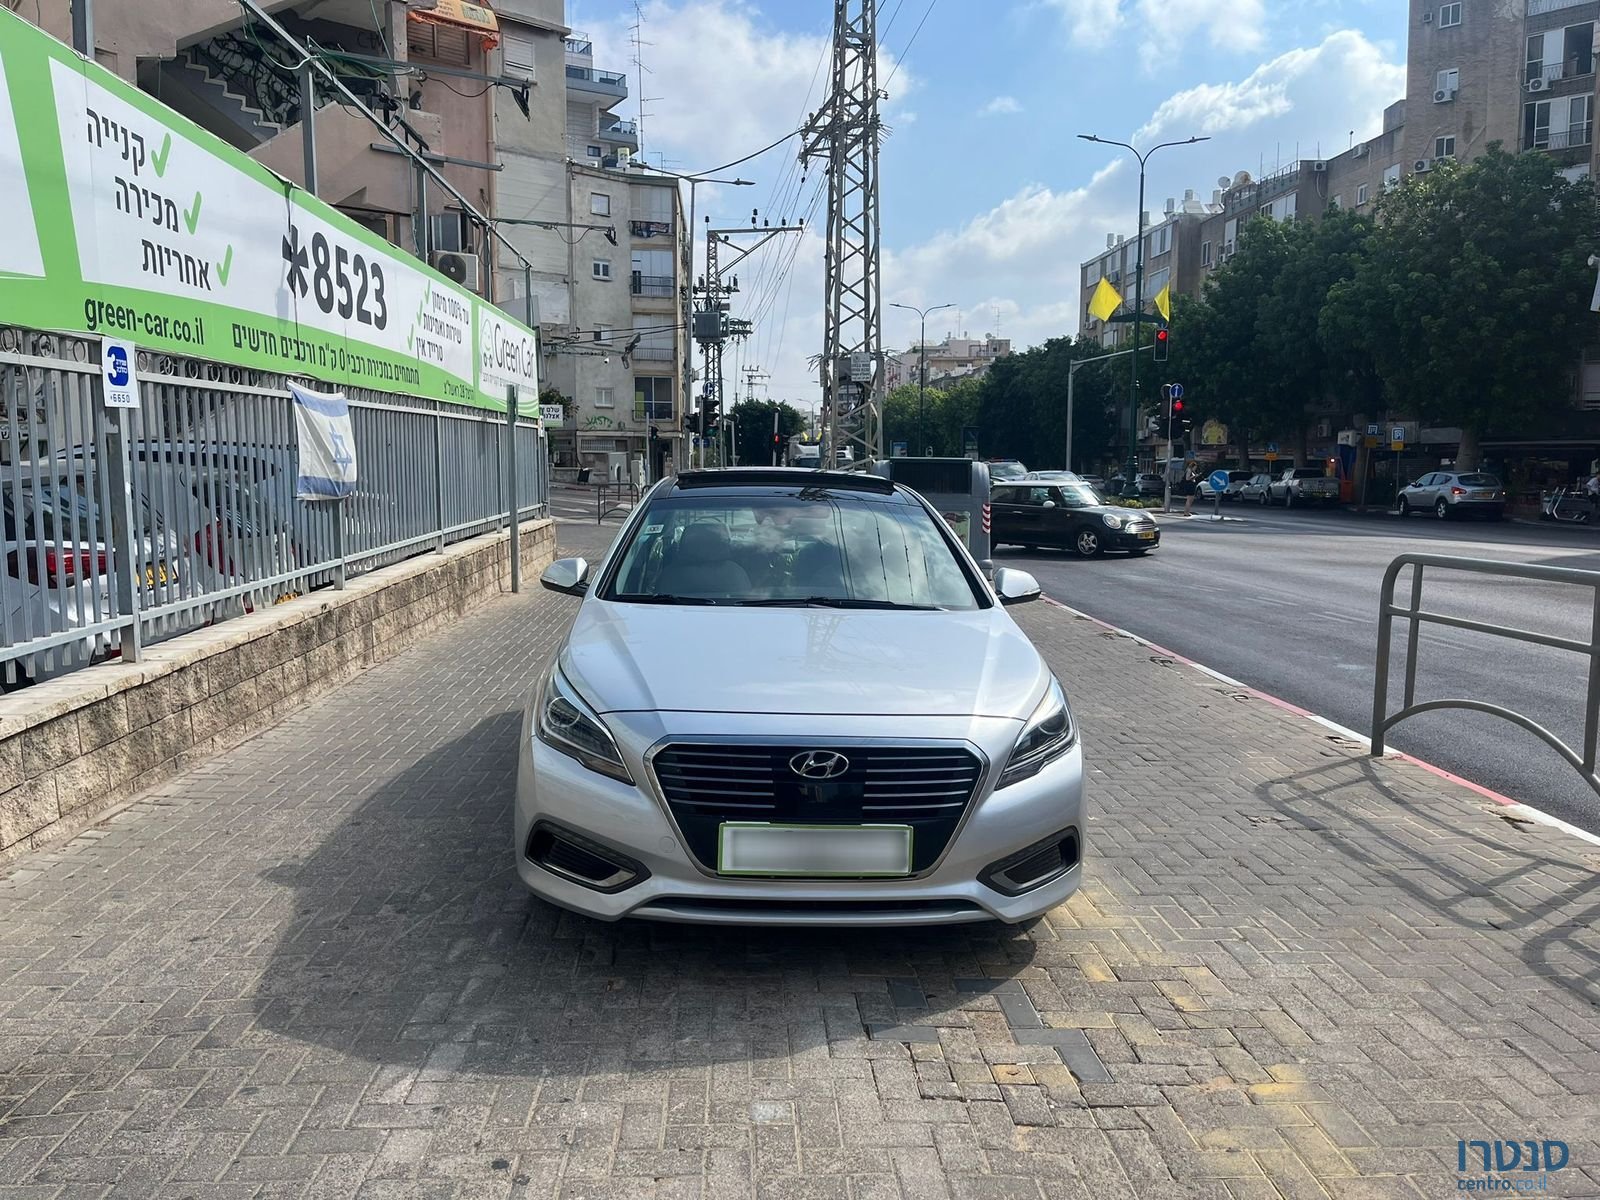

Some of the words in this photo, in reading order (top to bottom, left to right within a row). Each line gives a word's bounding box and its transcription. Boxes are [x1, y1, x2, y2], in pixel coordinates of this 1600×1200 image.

[87, 108, 145, 176] קנייה
[115, 176, 179, 233] מכירה
[142, 239, 211, 291] אחריות
[85, 299, 204, 345] green-car.co.il
[232, 323, 278, 357] חדשים
[280, 335, 317, 365] ורכבים
[416, 337, 427, 360] אין
[427, 341, 443, 361] טרייד
[494, 323, 521, 375] Green
[522, 338, 534, 379] Car
[347, 353, 367, 376] רכבי
[395, 364, 420, 385] מתמחים
